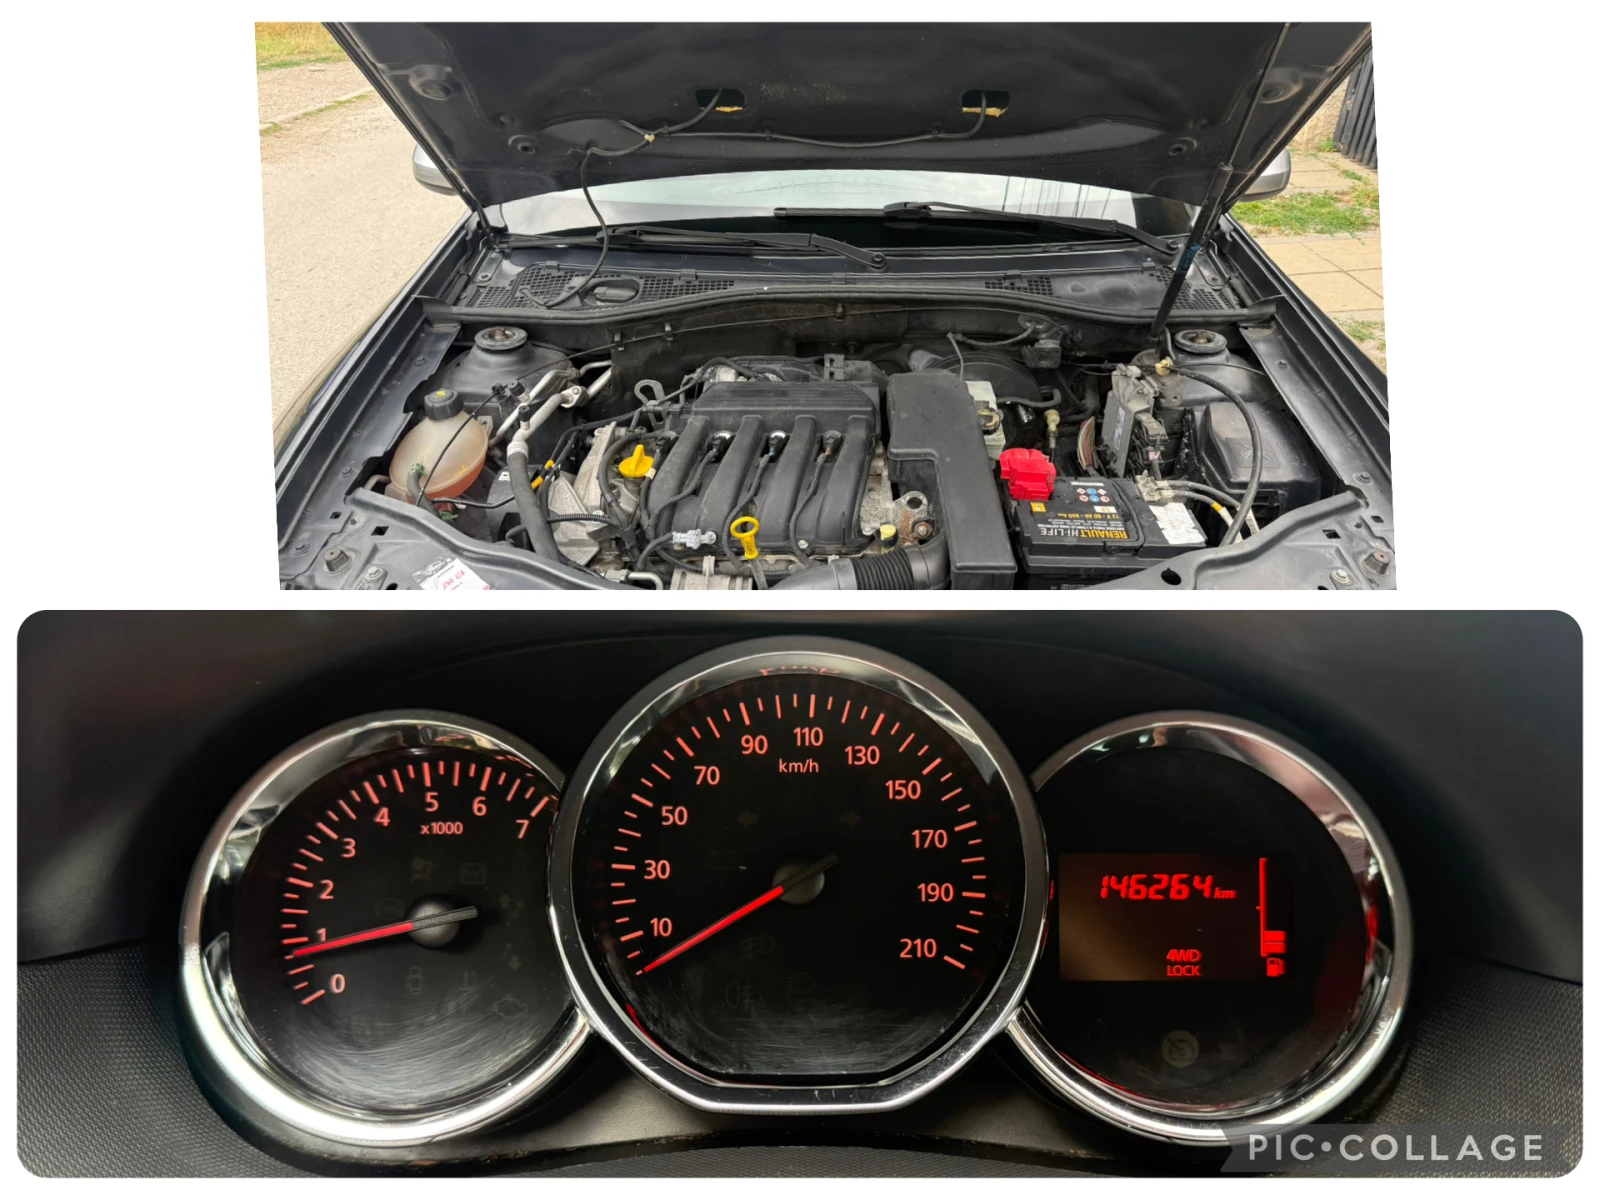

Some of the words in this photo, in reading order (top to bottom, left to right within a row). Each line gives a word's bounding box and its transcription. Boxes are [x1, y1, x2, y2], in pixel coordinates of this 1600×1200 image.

[1080, 529, 1128, 539] RENAULT
[740, 734, 769, 755] 90
[793, 726, 824, 747] 110
[778, 758, 819, 773] km/h
[844, 745, 881, 766] 130
[693, 765, 721, 786] 70
[885, 779, 922, 800] 150
[425, 791, 439, 813] 5
[472, 796, 487, 817] 6
[374, 807, 391, 827] 4
[661, 805, 688, 826] 50
[421, 821, 464, 835] x1000
[515, 819, 530, 839] 7
[342, 837, 357, 858] 3
[911, 829, 948, 849] 170
[644, 859, 671, 880] 30
[319, 879, 335, 900] 2
[917, 882, 954, 903] 190
[1100, 873, 1213, 900] 146264
[1213, 887, 1236, 900] km
[316, 927, 327, 943] 1
[650, 917, 673, 937] 10
[899, 938, 937, 959] 210
[1166, 949, 1202, 962] 4WD
[1166, 965, 1201, 977] LOCK
[329, 973, 346, 994] 0
